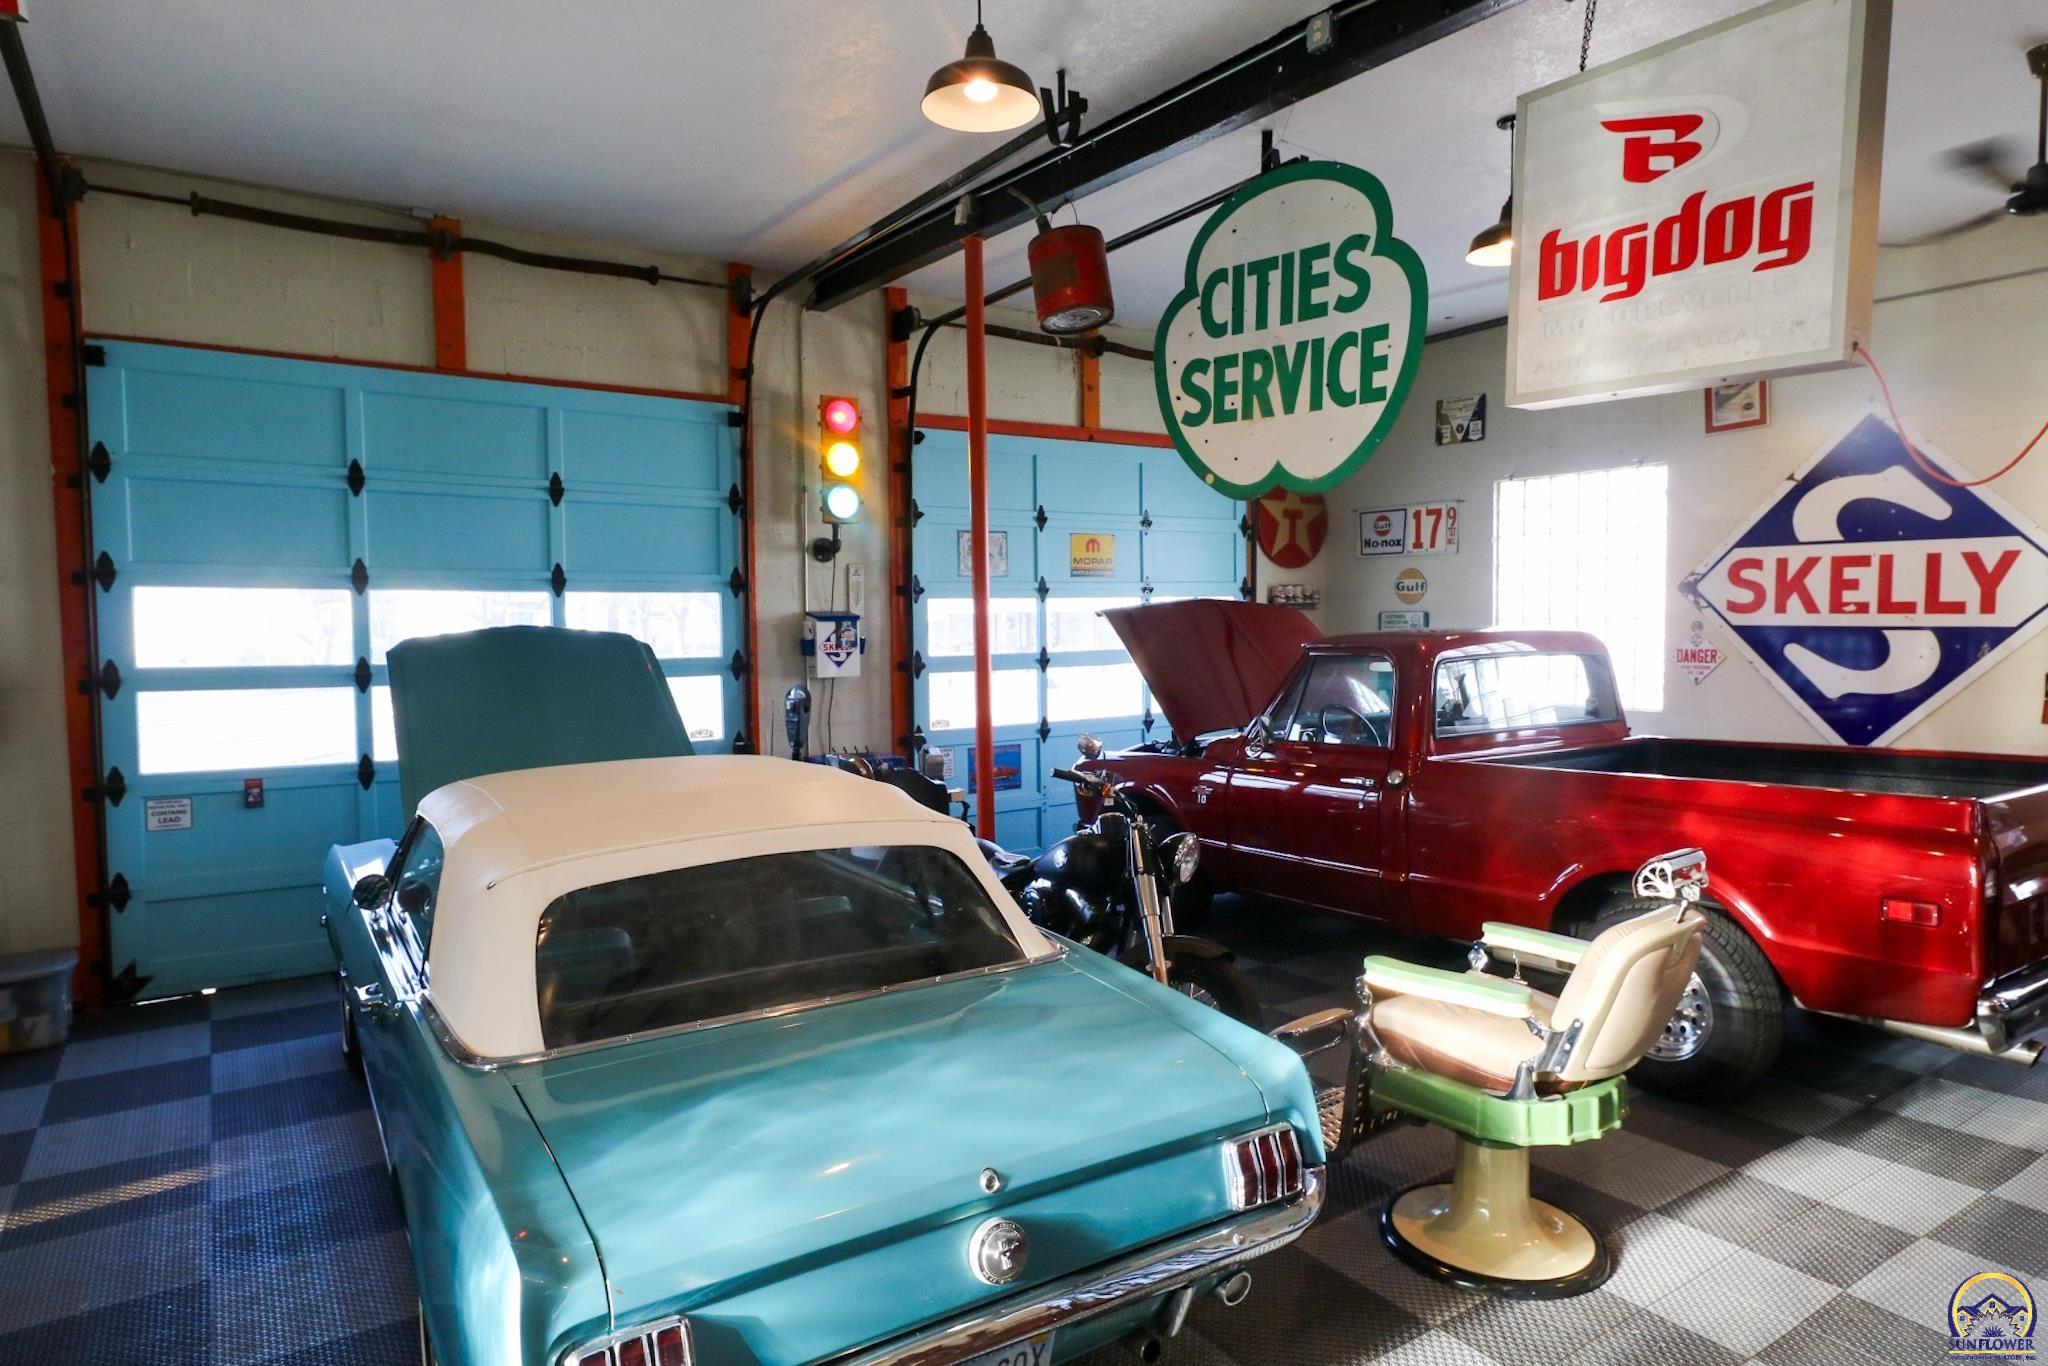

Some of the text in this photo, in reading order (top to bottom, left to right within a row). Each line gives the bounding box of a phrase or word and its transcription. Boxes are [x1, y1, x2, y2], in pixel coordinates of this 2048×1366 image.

[1538, 181, 1815, 303] bigdog
[1200, 233, 1372, 339] CITIES
[1180, 322, 1390, 428] SERVICE
[1374, 520, 1392, 530] Gulf
[1412, 506, 1443, 550] 17
[1447, 506, 1457, 526] 9
[1364, 537, 1403, 550] No-nox
[1073, 557, 1113, 566] MOPAR
[1396, 580, 1426, 592] Gulf
[1725, 549, 2023, 615] SKELLY
[1676, 648, 1718, 664] DANGER
